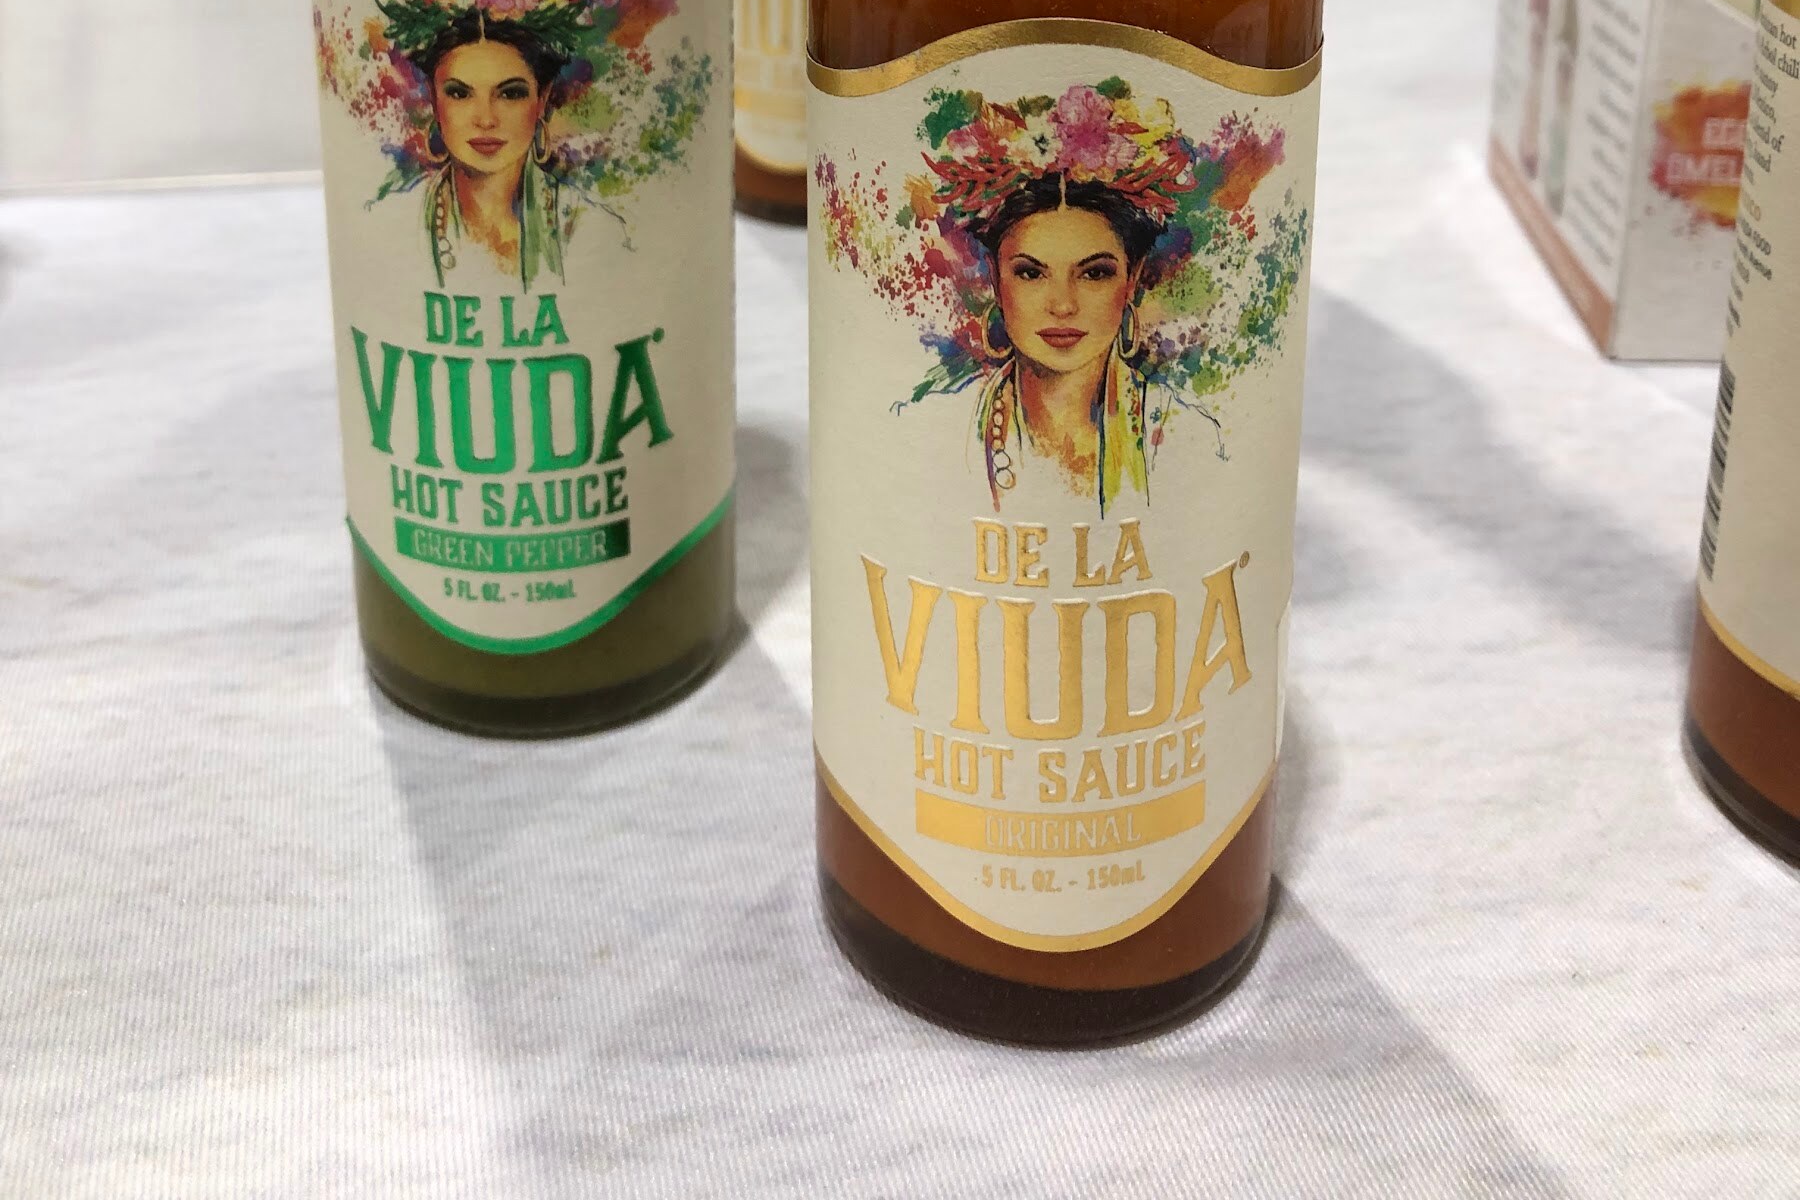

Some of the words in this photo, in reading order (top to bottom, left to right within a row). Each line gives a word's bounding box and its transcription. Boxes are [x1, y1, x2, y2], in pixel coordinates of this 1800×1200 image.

[424, 291, 484, 348] DE
[500, 293, 570, 348] LA
[351, 325, 674, 475] VIUDA
[390, 464, 464, 525] HOT
[481, 465, 629, 528] SAUCE
[412, 528, 495, 568] GREEN
[505, 529, 608, 568] PEPPER
[972, 516, 1049, 588] DE
[1071, 516, 1153, 588] LA
[443, 576, 454, 597] 5
[859, 552, 1252, 741] VIUDA
[912, 722, 1015, 801] HOT
[1037, 719, 1207, 803] SAUCE
[983, 810, 1142, 851] ORIGINAL
[982, 863, 994, 889] 5
[1000, 865, 1026, 892] FL.
[1031, 868, 1063, 893] OZ.
